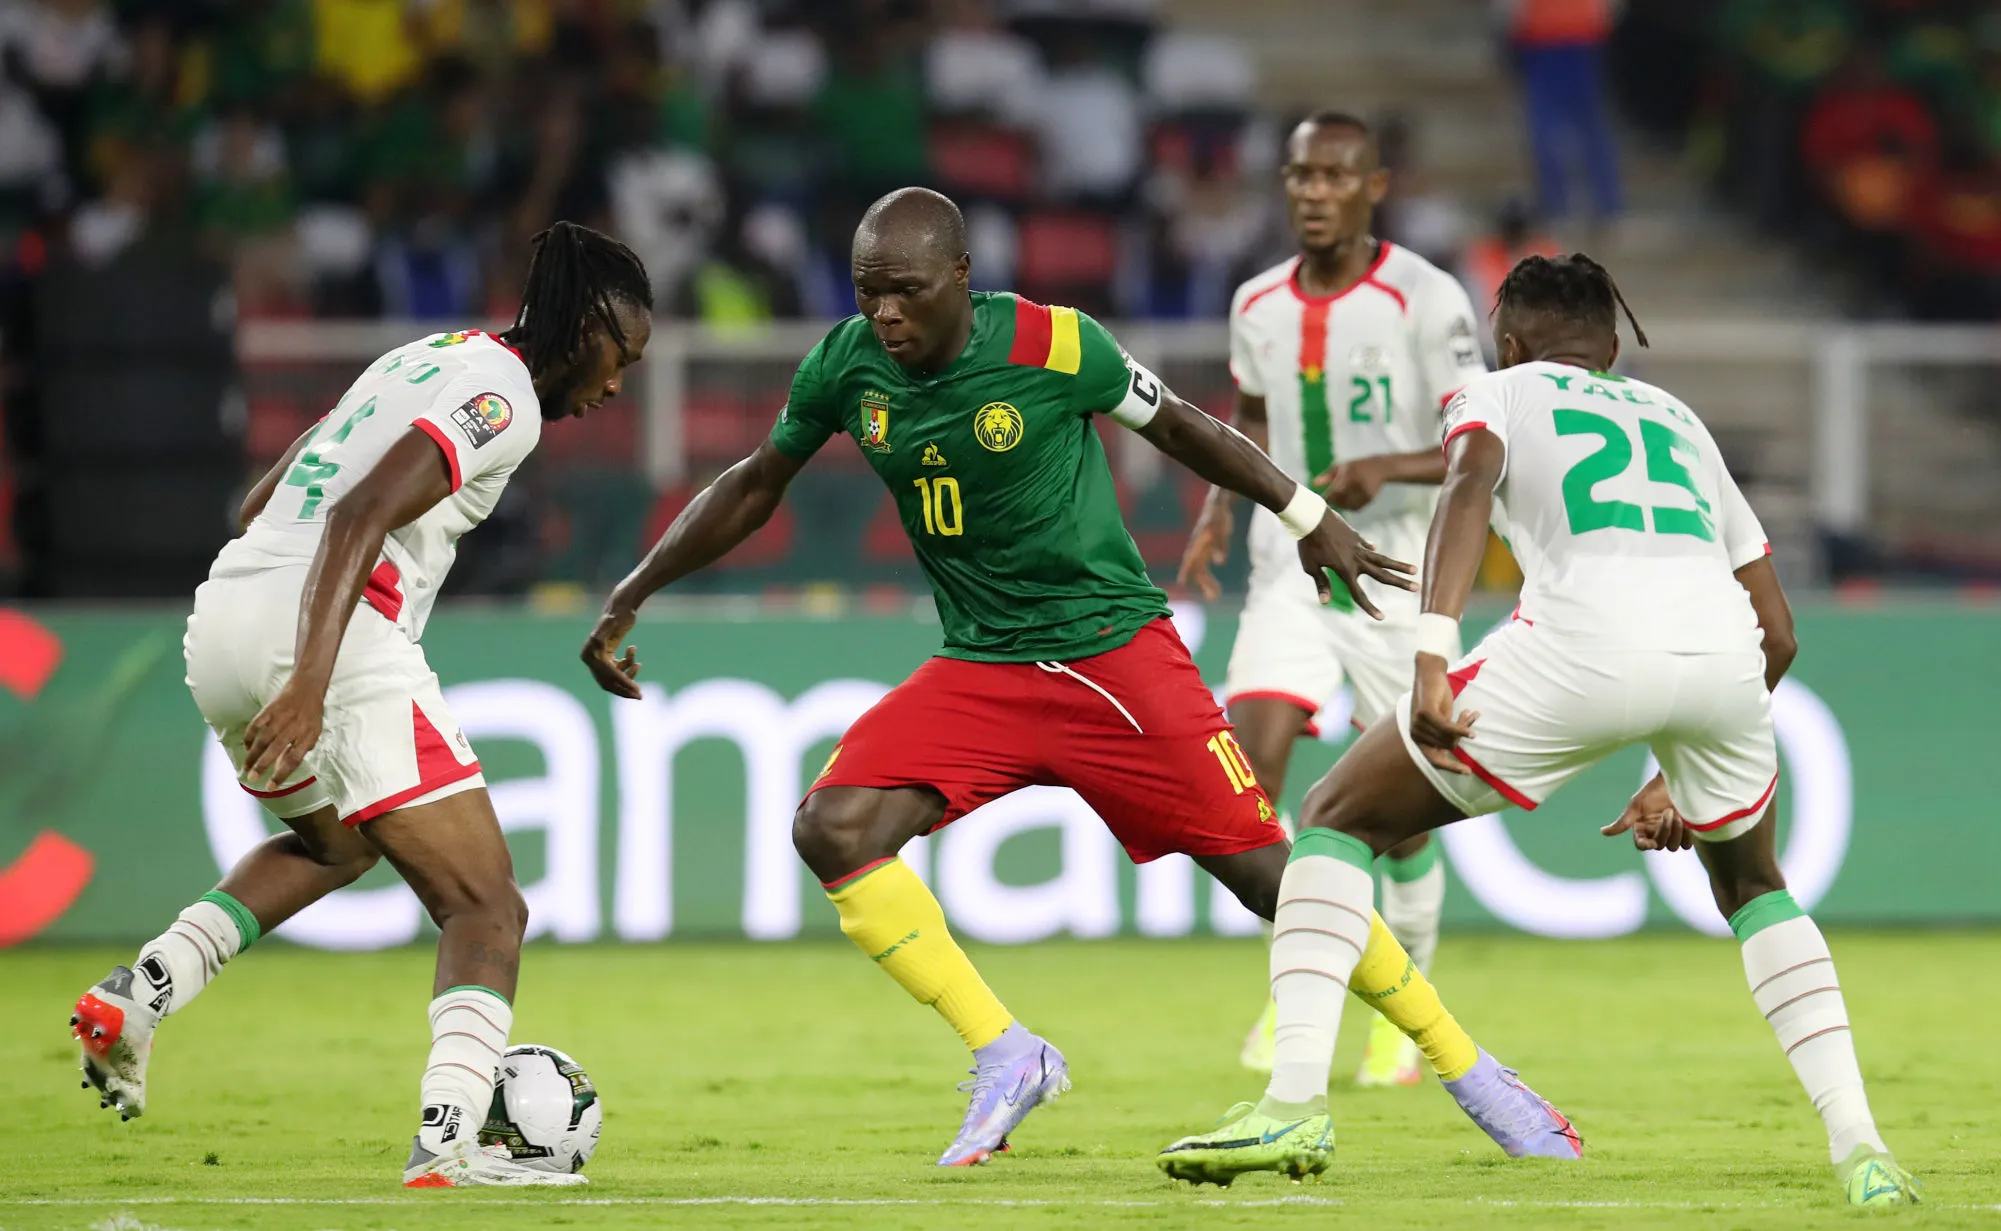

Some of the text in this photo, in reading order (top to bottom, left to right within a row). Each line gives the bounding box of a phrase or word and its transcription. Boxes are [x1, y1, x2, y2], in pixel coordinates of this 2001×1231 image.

[1132, 370, 1158, 407] C
[1350, 376, 1391, 424] 21
[469, 408, 491, 431] CAF
[280, 392, 378, 520] 4
[1552, 408, 1717, 544] 25
[913, 477, 964, 537] 10
[1207, 729, 1258, 795] 10
